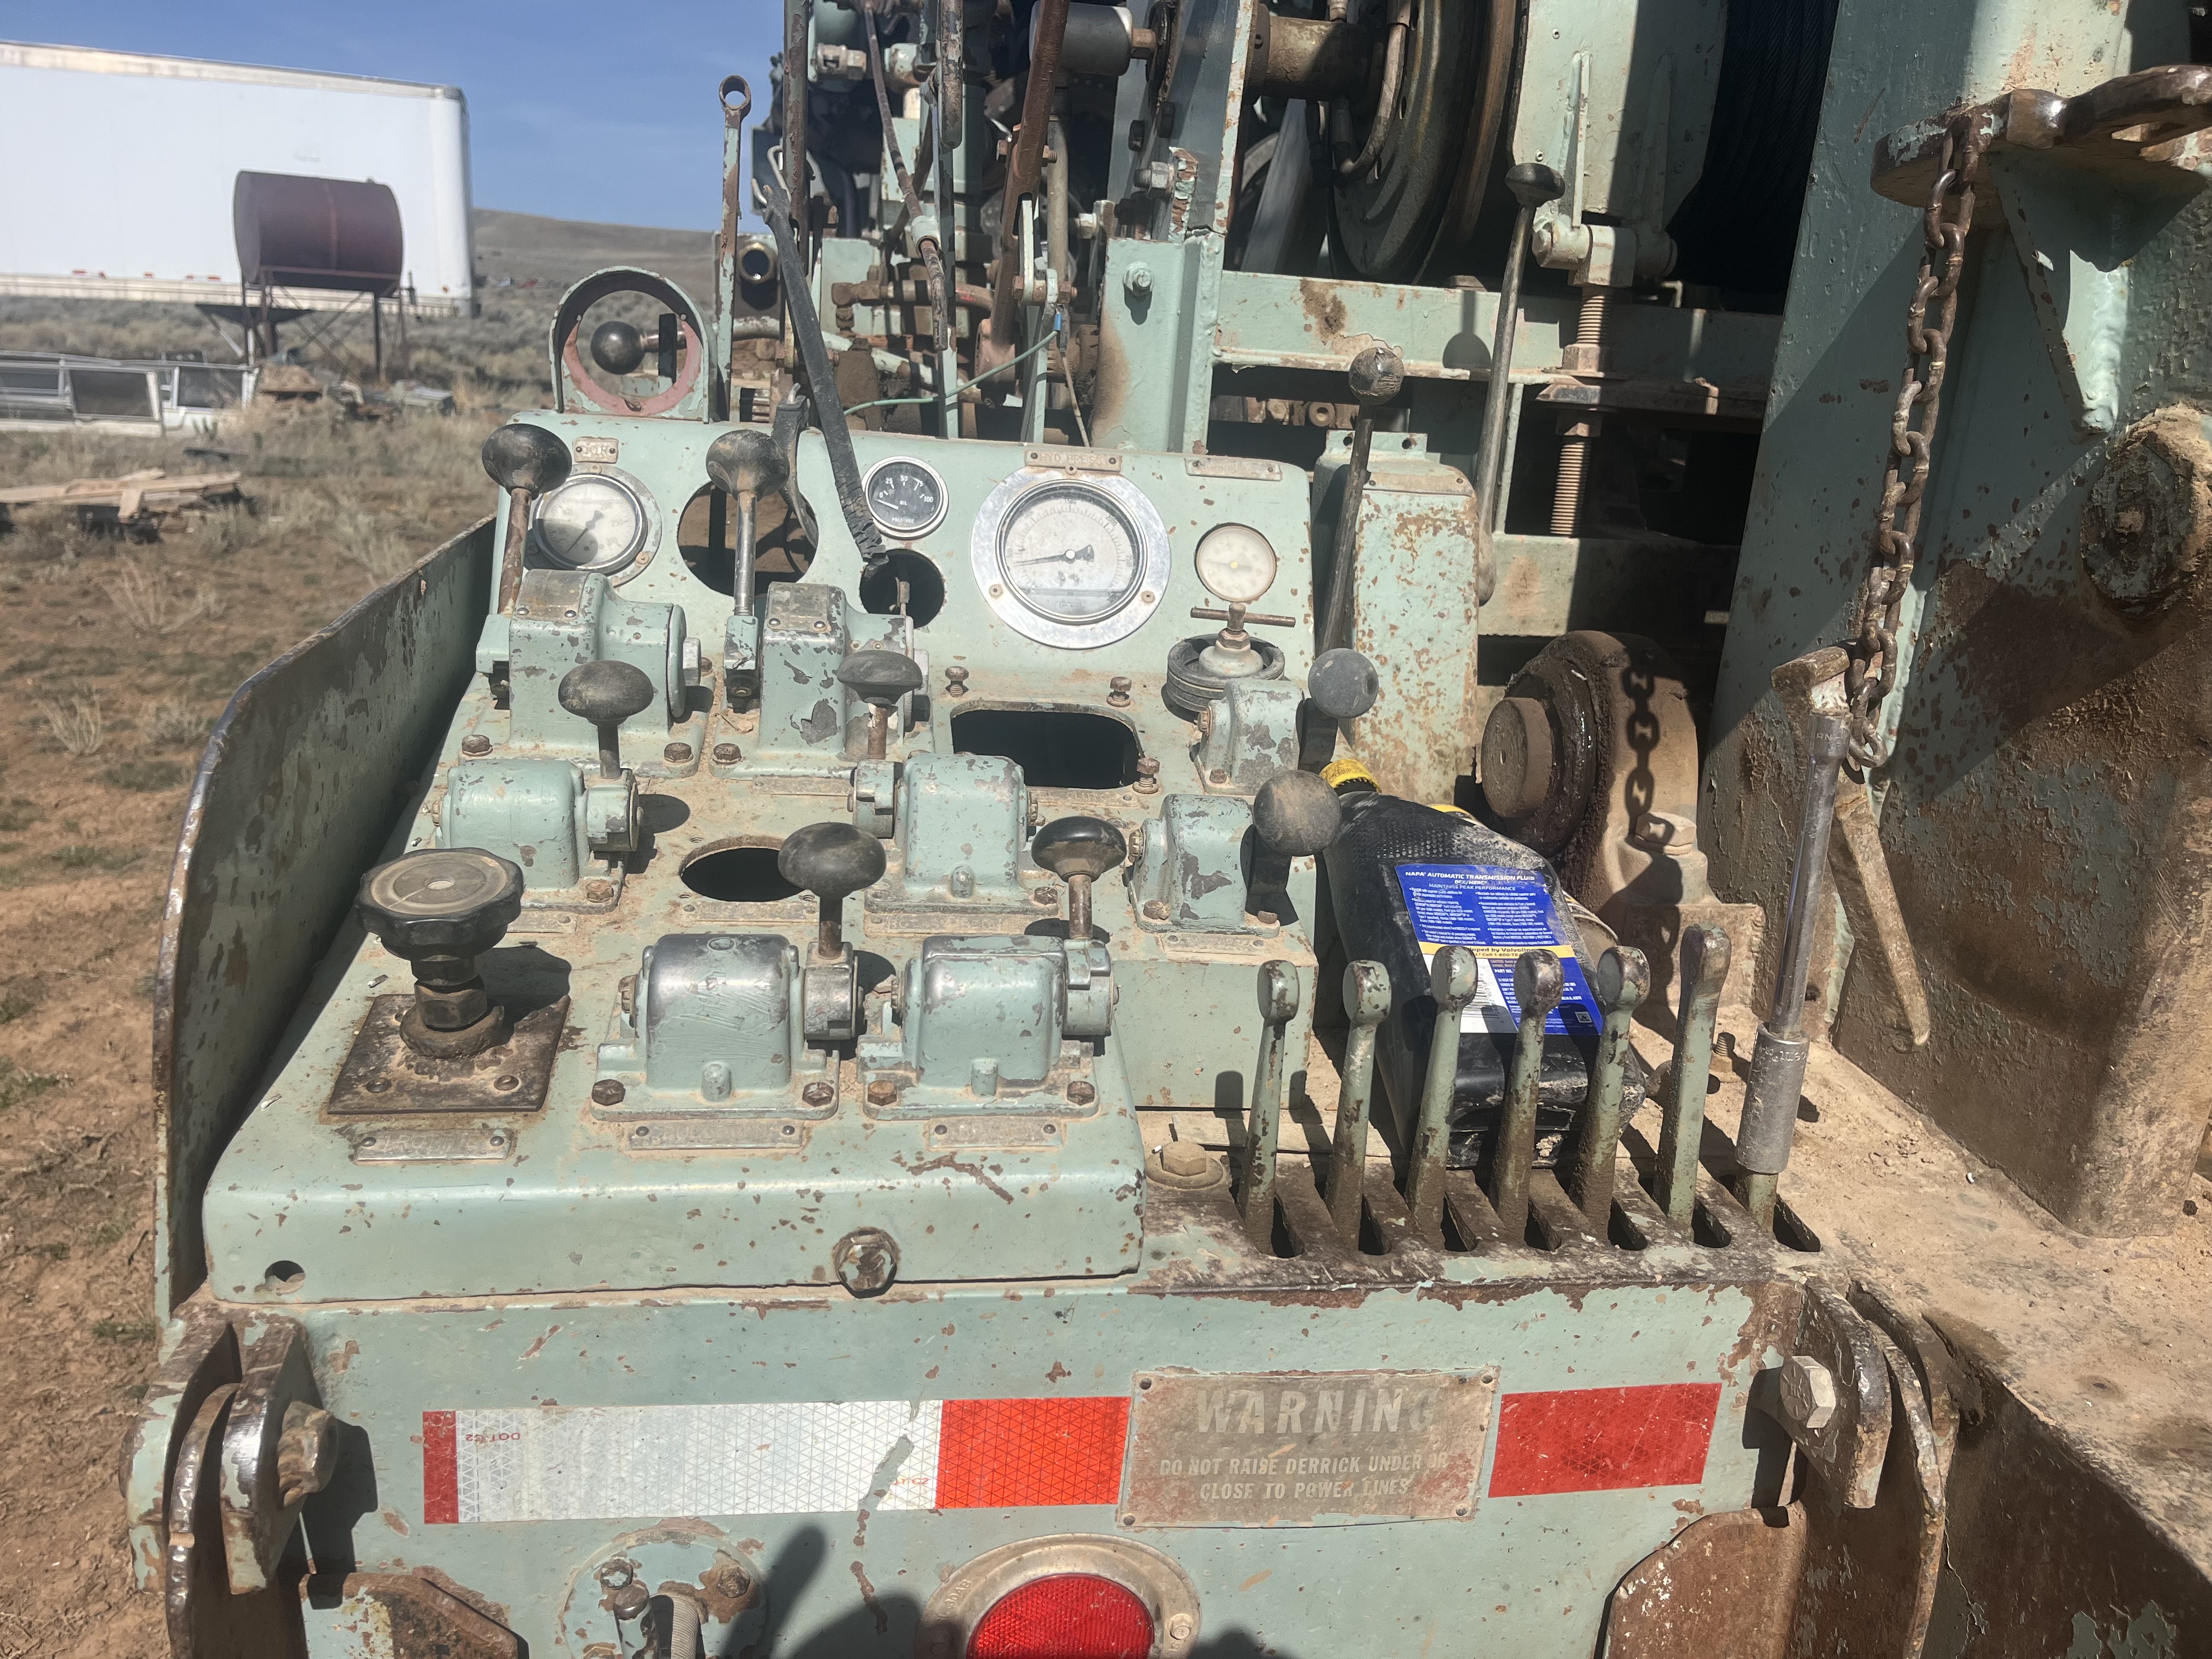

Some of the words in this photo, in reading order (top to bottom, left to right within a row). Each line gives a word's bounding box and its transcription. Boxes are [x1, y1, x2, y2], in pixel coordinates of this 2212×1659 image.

[1105, 514, 1118, 527] 2000
[1195, 1387, 1440, 1434] WARNING
[1159, 1459, 1183, 1476] DO
[1188, 1458, 1222, 1476] NOT
[1228, 1458, 1278, 1476] RAISE
[1285, 1457, 1361, 1475] DERRICK
[1367, 1455, 1422, 1473] UNDER
[1199, 1482, 1254, 1500] CLOSE
[1265, 1482, 1285, 1500] TO
[1293, 1481, 1355, 1500] POWER
[1361, 1479, 1409, 1496] LINES
